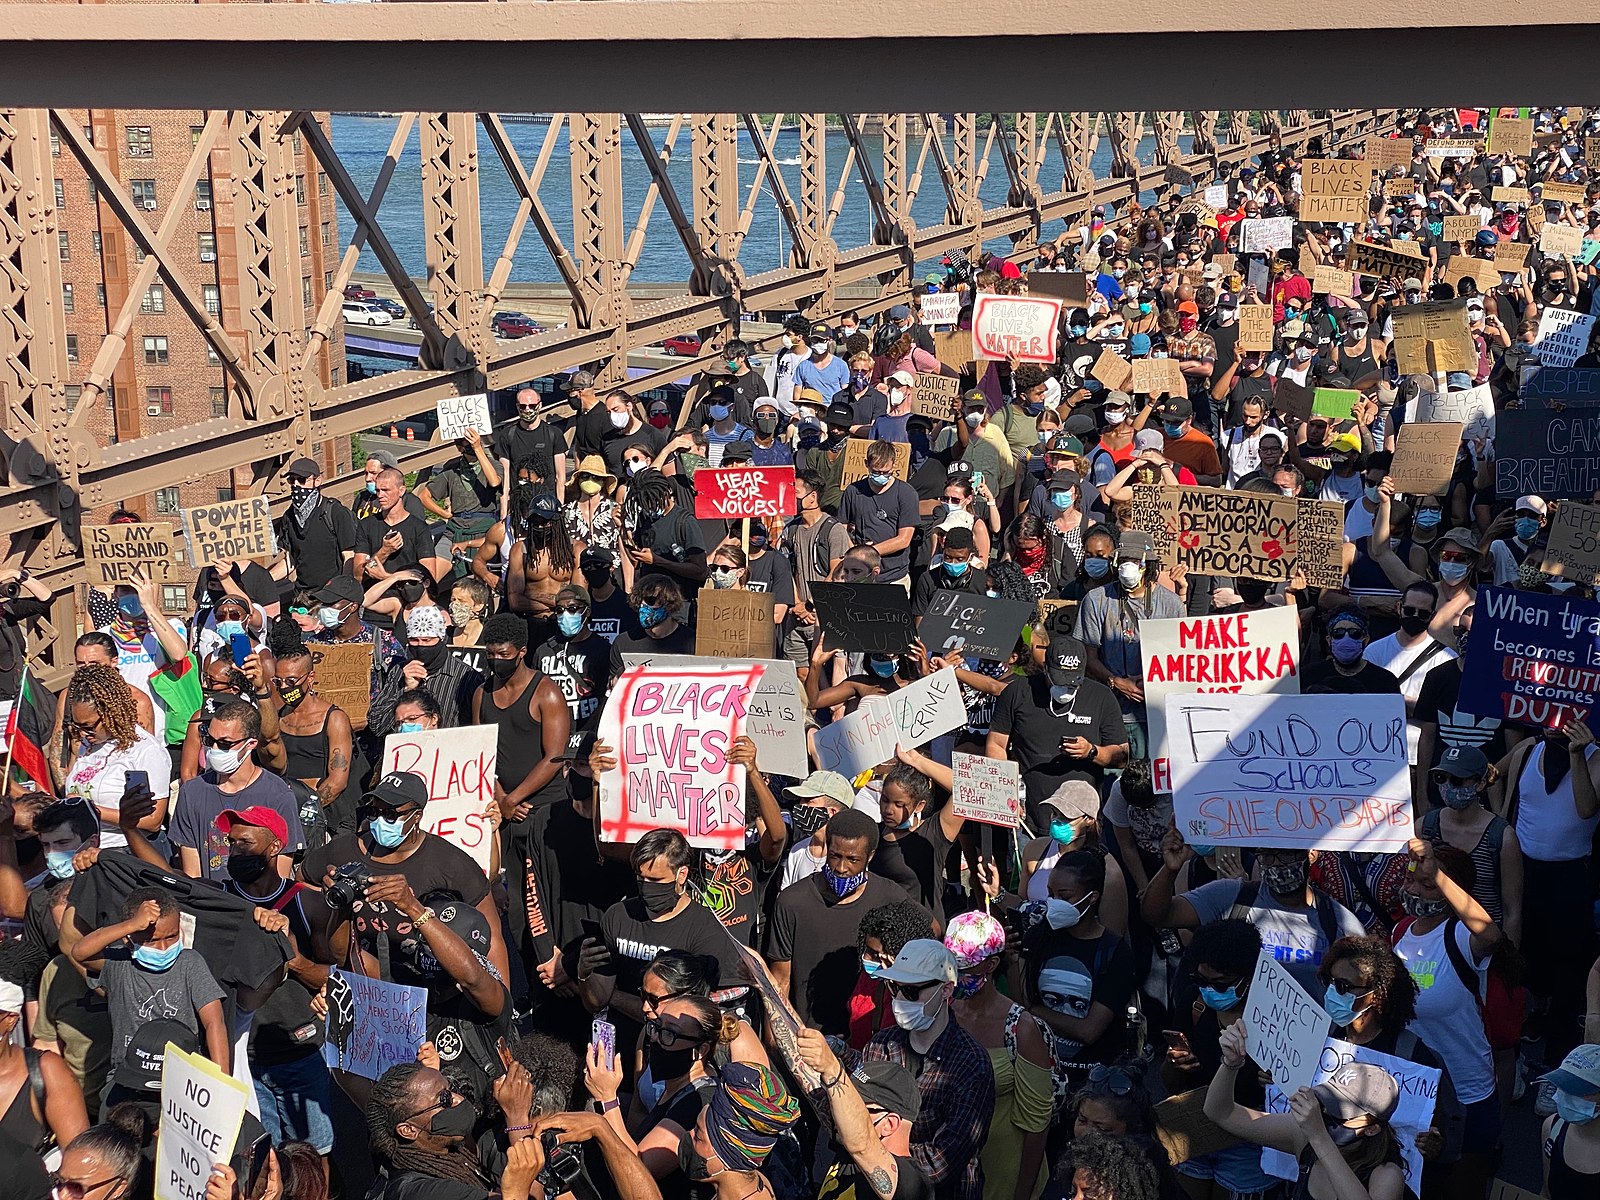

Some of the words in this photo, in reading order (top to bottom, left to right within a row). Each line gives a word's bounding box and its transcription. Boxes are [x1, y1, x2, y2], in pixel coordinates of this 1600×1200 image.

[1311, 162, 1362, 177] BLACK
[1310, 178, 1363, 194] LIVES
[1310, 198, 1367, 214] MATTER
[1445, 218, 1480, 228] ABOLISH
[1452, 229, 1478, 238] NYPD
[1357, 244, 1391, 260] BLACK
[1357, 257, 1417, 281] MATTER
[991, 304, 1041, 321] BLACK
[1241, 307, 1272, 318] DEFUND
[1549, 310, 1588, 326] JUSTICE
[990, 318, 1034, 336] LIVES
[1248, 320, 1264, 331] THE
[1556, 322, 1573, 333] FOR
[985, 333, 1044, 355] MATTER
[1240, 331, 1271, 343] POLICE
[1544, 332, 1582, 347] GEORGE
[1537, 341, 1579, 358] BREONNA
[915, 374, 949, 391] JUSTICE
[950, 380, 958, 394] 4
[440, 396, 487, 415] BLACK
[1421, 389, 1484, 408] BLACK
[446, 411, 482, 427] LIVES
[920, 403, 951, 418] FLOYD
[1431, 406, 1485, 421] LIVES
[1397, 430, 1442, 447] BLACK
[1392, 447, 1455, 466] COMMUNITIES
[715, 472, 769, 491] HEAR
[1391, 467, 1434, 481] MATTER
[726, 486, 764, 500] OUR
[1132, 485, 1166, 493] GEORGE
[1132, 492, 1161, 500] FLOYD
[712, 481, 786, 517] VOICES!
[1132, 501, 1173, 510] BREONNA
[1178, 492, 1273, 517] AMERICAN
[1298, 500, 1323, 510] ERIC
[191, 500, 268, 532] POWER
[1132, 508, 1161, 517] TAYLOR
[1297, 508, 1337, 518] GARNER
[1298, 516, 1339, 526] PHILANDO
[93, 528, 110, 543] IS
[125, 526, 155, 542] MY
[196, 531, 216, 544] TO
[220, 518, 264, 540] THE
[1178, 511, 1297, 544] DEMOCRACY
[1297, 524, 1337, 534] CASTILE
[1207, 533, 1231, 549] IS
[1237, 536, 1252, 553] A
[1298, 531, 1334, 542] SAMUEL
[1298, 540, 1339, 550] DUBOSE
[91, 543, 169, 559] HUSBAND
[201, 533, 266, 563] PEOPLE
[1297, 548, 1331, 558] SANDRA
[1177, 546, 1297, 579] HYPOCRISY
[1297, 555, 1328, 564] BLAND
[100, 559, 170, 582] NEXT?
[1304, 570, 1342, 579] ERRENCE
[1305, 578, 1342, 589] RUTCHER
[712, 606, 766, 622] DEFUND
[845, 606, 911, 626] KILLING
[1485, 590, 1549, 627] When
[588, 621, 615, 632] LACK
[721, 629, 746, 641] THE
[1179, 614, 1251, 650] MAKE
[1494, 629, 1576, 662] becomes
[312, 651, 368, 668] BLACK
[1146, 642, 1297, 683] AMERIKKKA
[632, 682, 752, 719] BLACK
[1514, 682, 1595, 705] becomes
[778, 706, 796, 721] is
[910, 678, 951, 739] CRIME
[1508, 694, 1588, 727] DUTY
[751, 723, 787, 738] Luther
[1179, 705, 1322, 764] FUND
[1337, 717, 1406, 761] OUR
[625, 722, 728, 776] LIVES
[819, 723, 865, 772] SKIN
[861, 712, 893, 743] TONE
[391, 742, 496, 803] BLACK
[959, 762, 973, 772] HEAR
[988, 767, 1000, 776] SEE
[1232, 756, 1377, 792] SCHOOLS
[958, 770, 971, 779] FEEL
[998, 777, 1016, 787] FEAR
[979, 781, 993, 792] CRY
[959, 785, 976, 797] PRAY
[628, 767, 746, 838] MATTER
[960, 794, 986, 806] FIGHT
[1198, 797, 1272, 839] SAVE
[1274, 797, 1330, 832] OUR
[1331, 797, 1412, 833] BABIES
[722, 914, 749, 928] OLCOM
[356, 982, 388, 1004] HANDS
[393, 989, 411, 1006] UP
[1258, 959, 1323, 1035] PROTECT
[367, 1004, 390, 1019] MEANS
[1270, 1003, 1299, 1042] NYC
[1252, 1006, 1302, 1069] DEFUND
[1256, 1040, 1291, 1084] NYPD
[185, 1078, 212, 1109] NO
[165, 1100, 223, 1156] JUSTICE
[179, 1146, 202, 1177] NO
